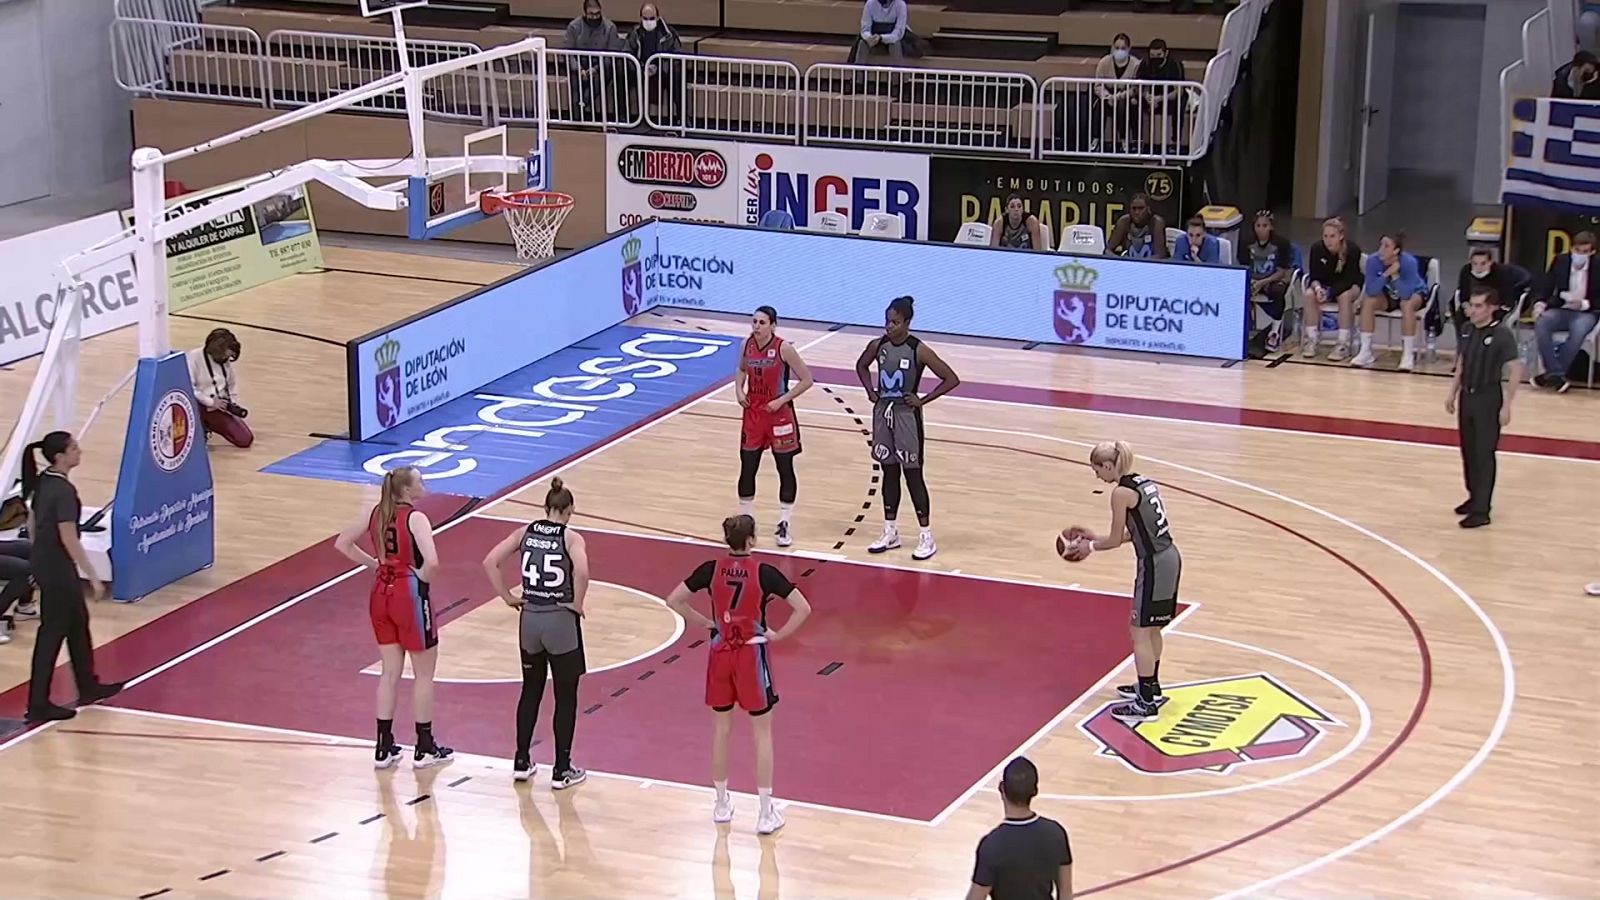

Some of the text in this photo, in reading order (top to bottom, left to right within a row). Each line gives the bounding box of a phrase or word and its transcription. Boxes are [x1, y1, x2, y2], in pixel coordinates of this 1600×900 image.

[996, 176, 1114, 195] EMBUTIDOS
[1147, 178, 1171, 194] 75
[961, 194, 1125, 243] PAARIE
[219, 224, 245, 240] CARPAS
[645, 254, 734, 275] DIPUTACIÓN
[645, 272, 703, 290] DE LEÓN
[0, 269, 139, 344] ALCRCE
[1106, 293, 1220, 317] DIPUTACIÓN
[1106, 313, 1184, 333] DE LEÓN
[405, 337, 466, 378] DIPUTACIÓN
[405, 366, 448, 399] DE LEÓN
[521, 551, 565, 588] 45
[720, 567, 749, 579] PALMA
[726, 580, 744, 610] 7
